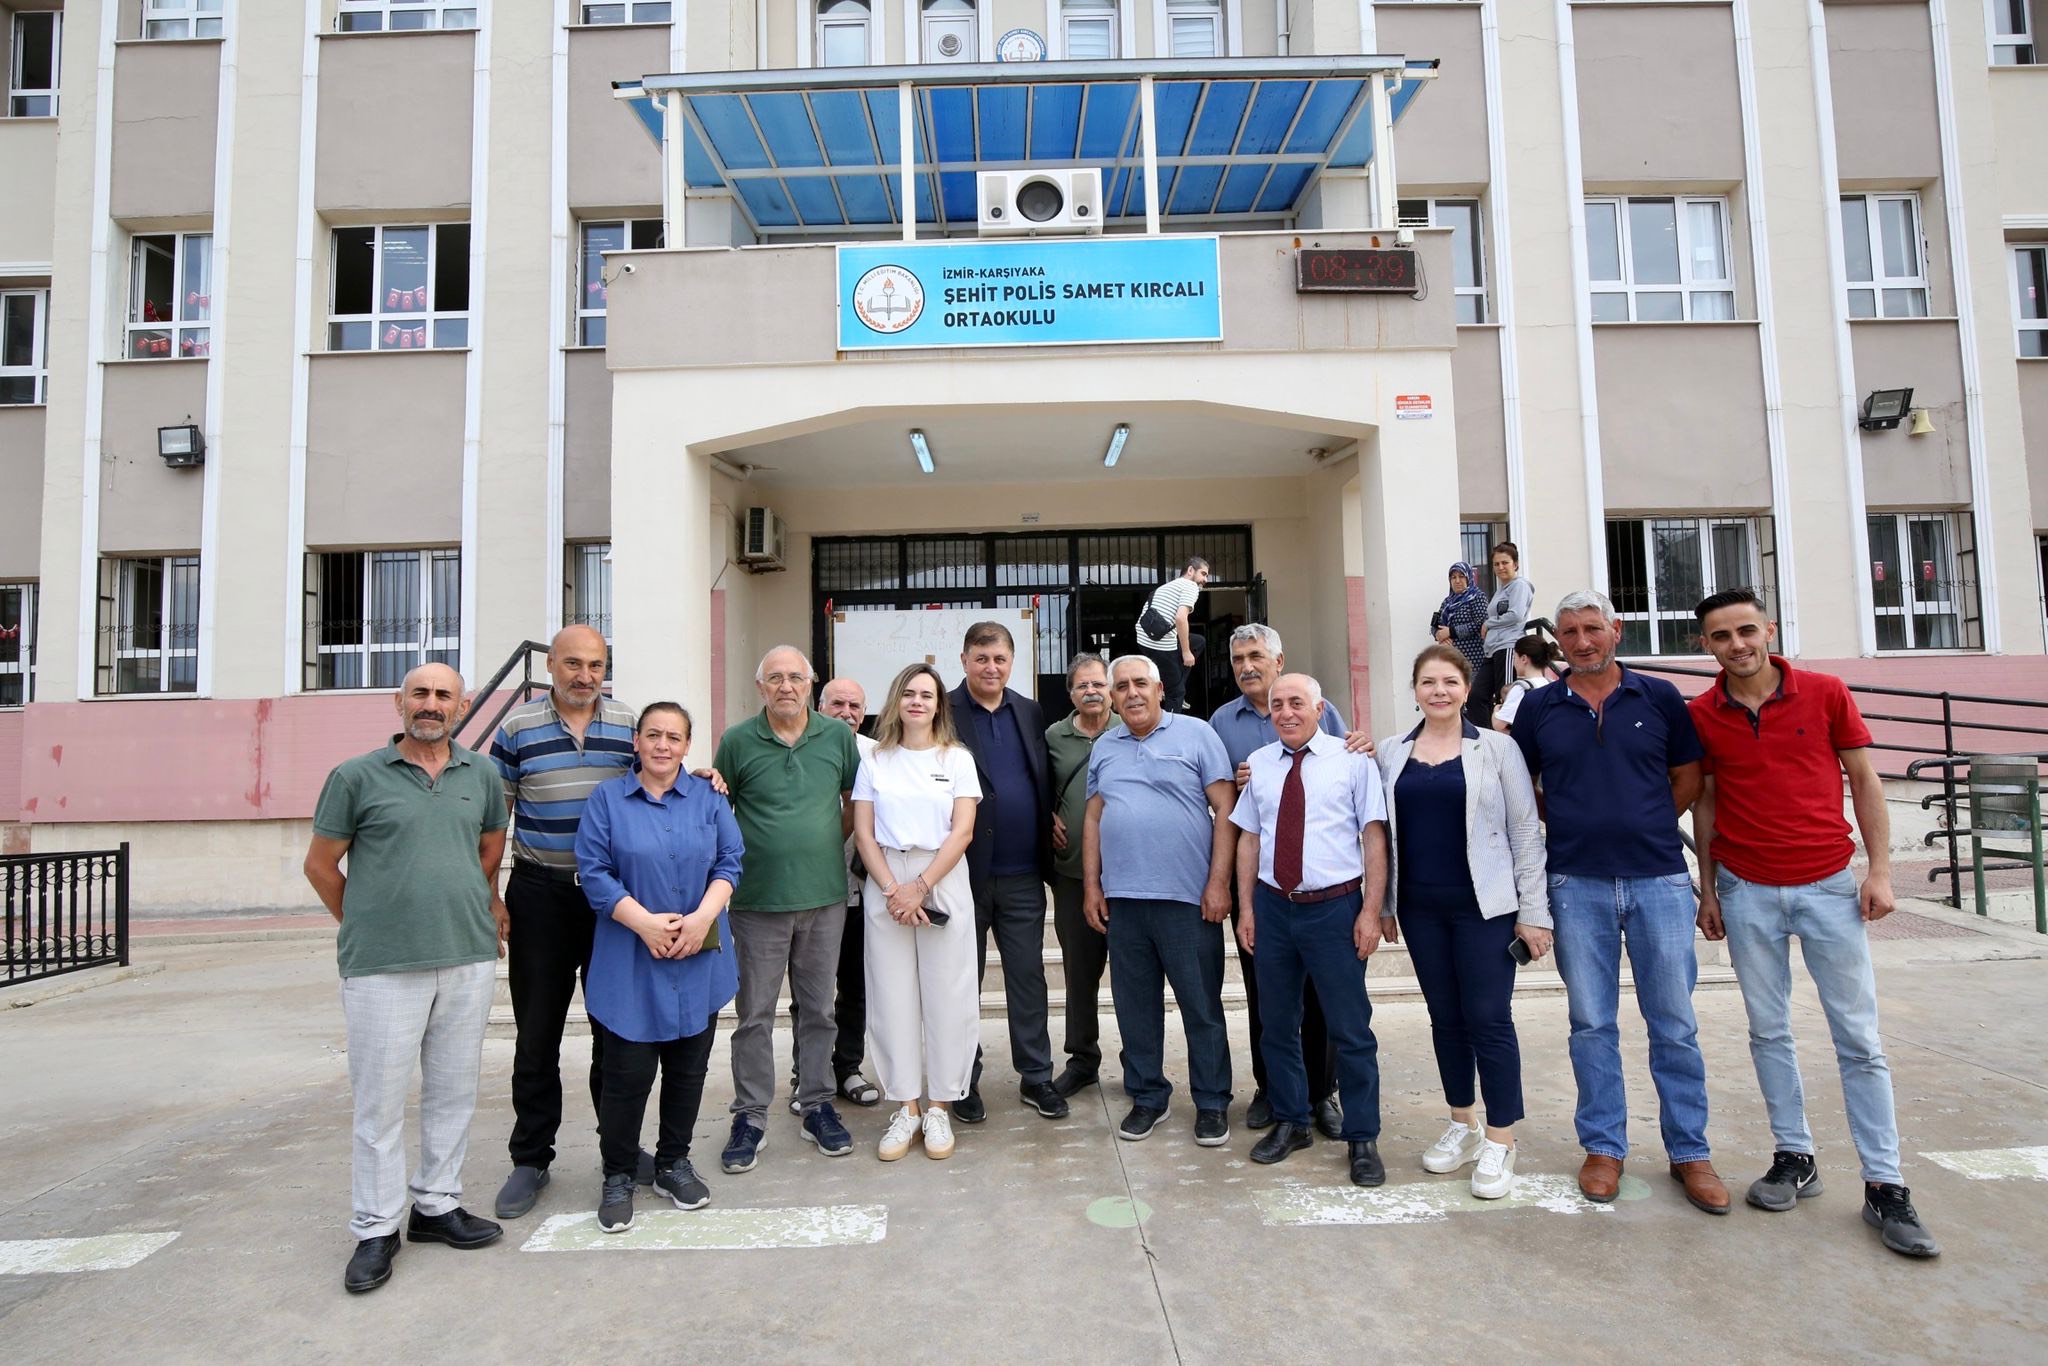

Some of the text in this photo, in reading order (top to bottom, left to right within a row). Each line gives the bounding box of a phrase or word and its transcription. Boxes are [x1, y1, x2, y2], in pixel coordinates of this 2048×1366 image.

[943, 267, 1045, 279] İZMİR-KARŞIYAKA
[1311, 255, 1405, 283] 08:39
[944, 281, 1204, 305] ŞEHİT POLİS SAMET KIRCALI
[944, 309, 1056, 327] ORTAOKULU
